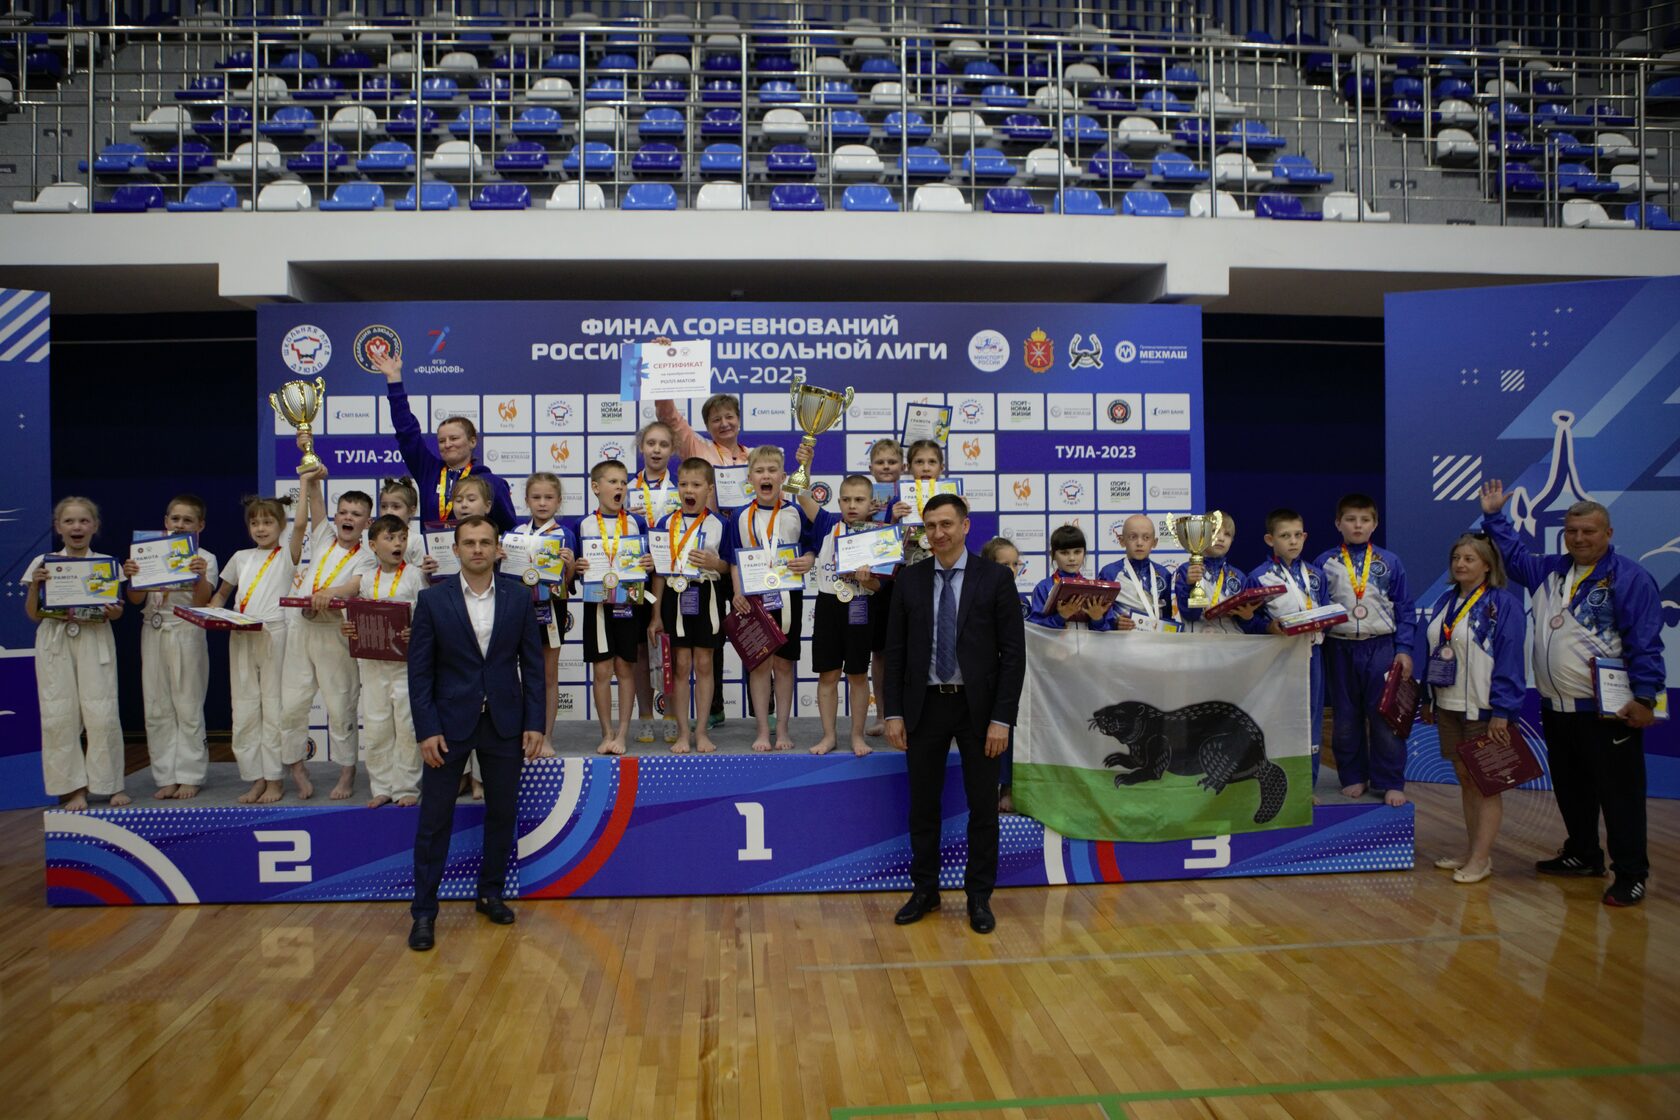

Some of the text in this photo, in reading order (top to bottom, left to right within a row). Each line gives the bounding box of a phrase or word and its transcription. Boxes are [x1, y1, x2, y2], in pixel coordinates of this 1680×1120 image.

[581, 315, 898, 335] ФИНАЛ СОРЕВНОВАНИЙ
[532, 338, 947, 360] РОССИ ШКОЛЬНОЙ ЛИГИ
[1139, 350, 1188, 360] МЕХМАШ
[414, 365, 465, 375] «ФЦОМОФВ»
[653, 361, 704, 370] СЕРТИФИКАТ
[709, 367, 807, 384] ЛА-2023
[334, 449, 404, 464] ТУЛА-20
[1055, 445, 1137, 459] ТУЛА-2023
[735, 802, 773, 860] 1
[254, 830, 312, 883] 2
[1184, 833, 1231, 869] 3
